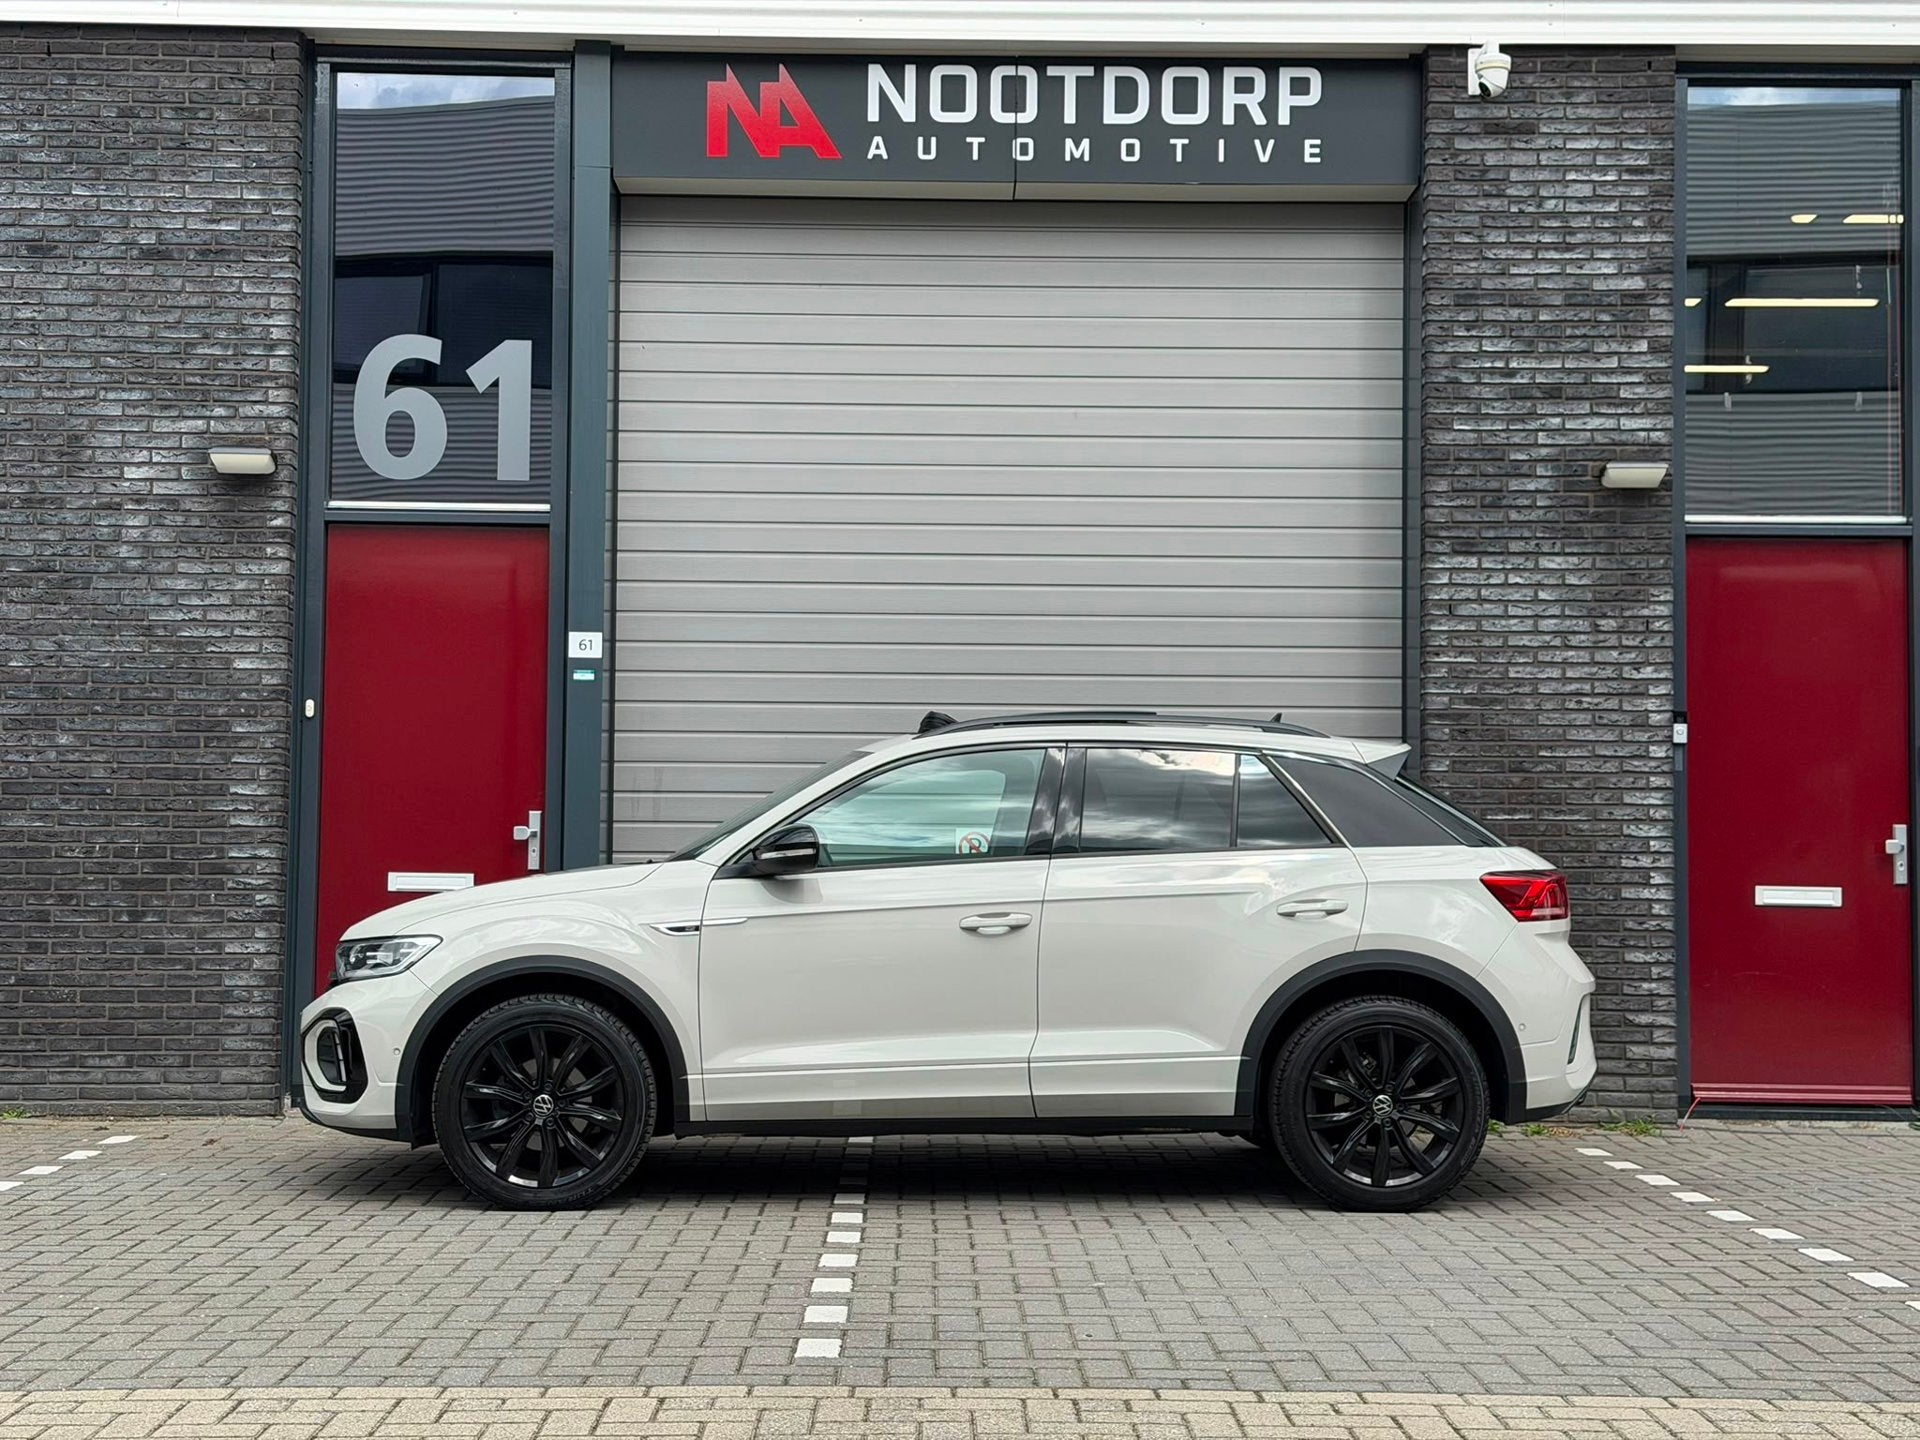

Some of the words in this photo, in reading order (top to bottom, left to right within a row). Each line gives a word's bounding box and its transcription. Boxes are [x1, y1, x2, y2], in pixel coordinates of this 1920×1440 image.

[866, 63, 1322, 126] NOOTDORP
[866, 135, 1322, 164] AUTOMOTIVE
[353, 333, 533, 481] 61
[578, 638, 593, 652] 61
